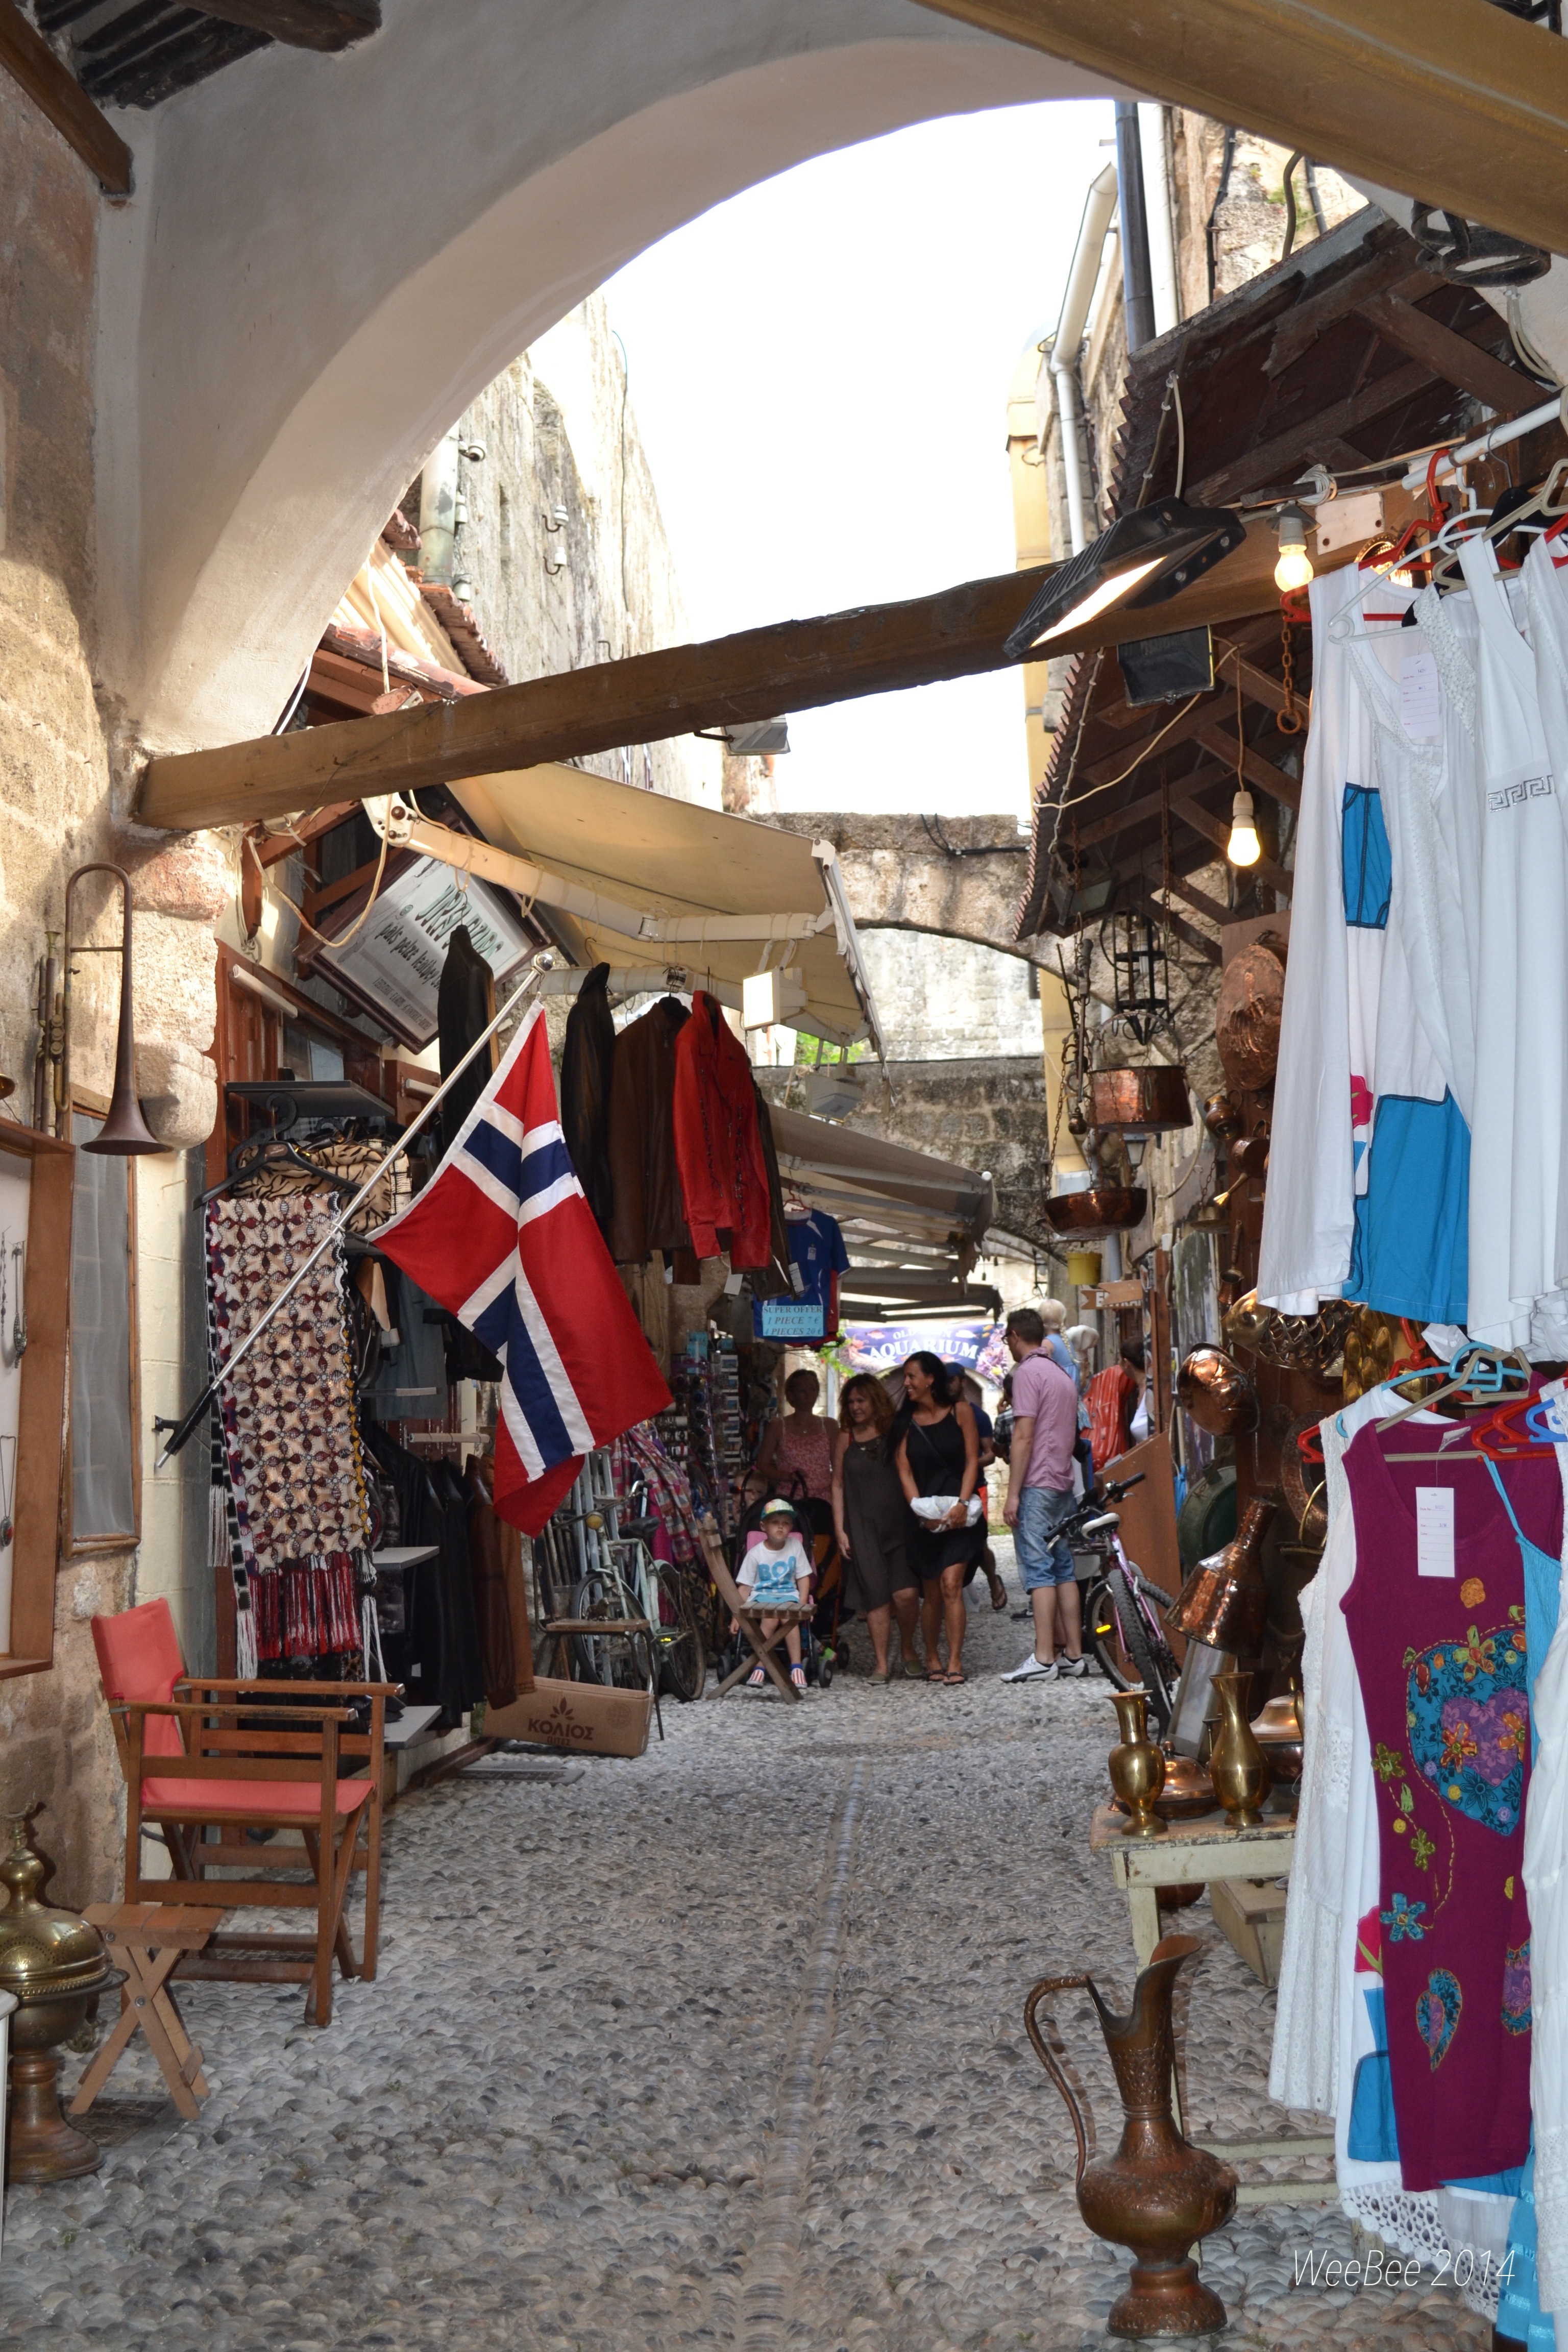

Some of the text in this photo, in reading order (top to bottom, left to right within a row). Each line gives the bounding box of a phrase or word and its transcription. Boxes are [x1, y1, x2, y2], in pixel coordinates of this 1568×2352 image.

[775, 1316, 804, 1325] PIECE
[807, 1316, 812, 1324] 7
[894, 1329, 915, 1339] OLD
[870, 1339, 979, 1360] AQUARIUM
[528, 1718, 594, 1740] ΚΟΛΙΟΣ
